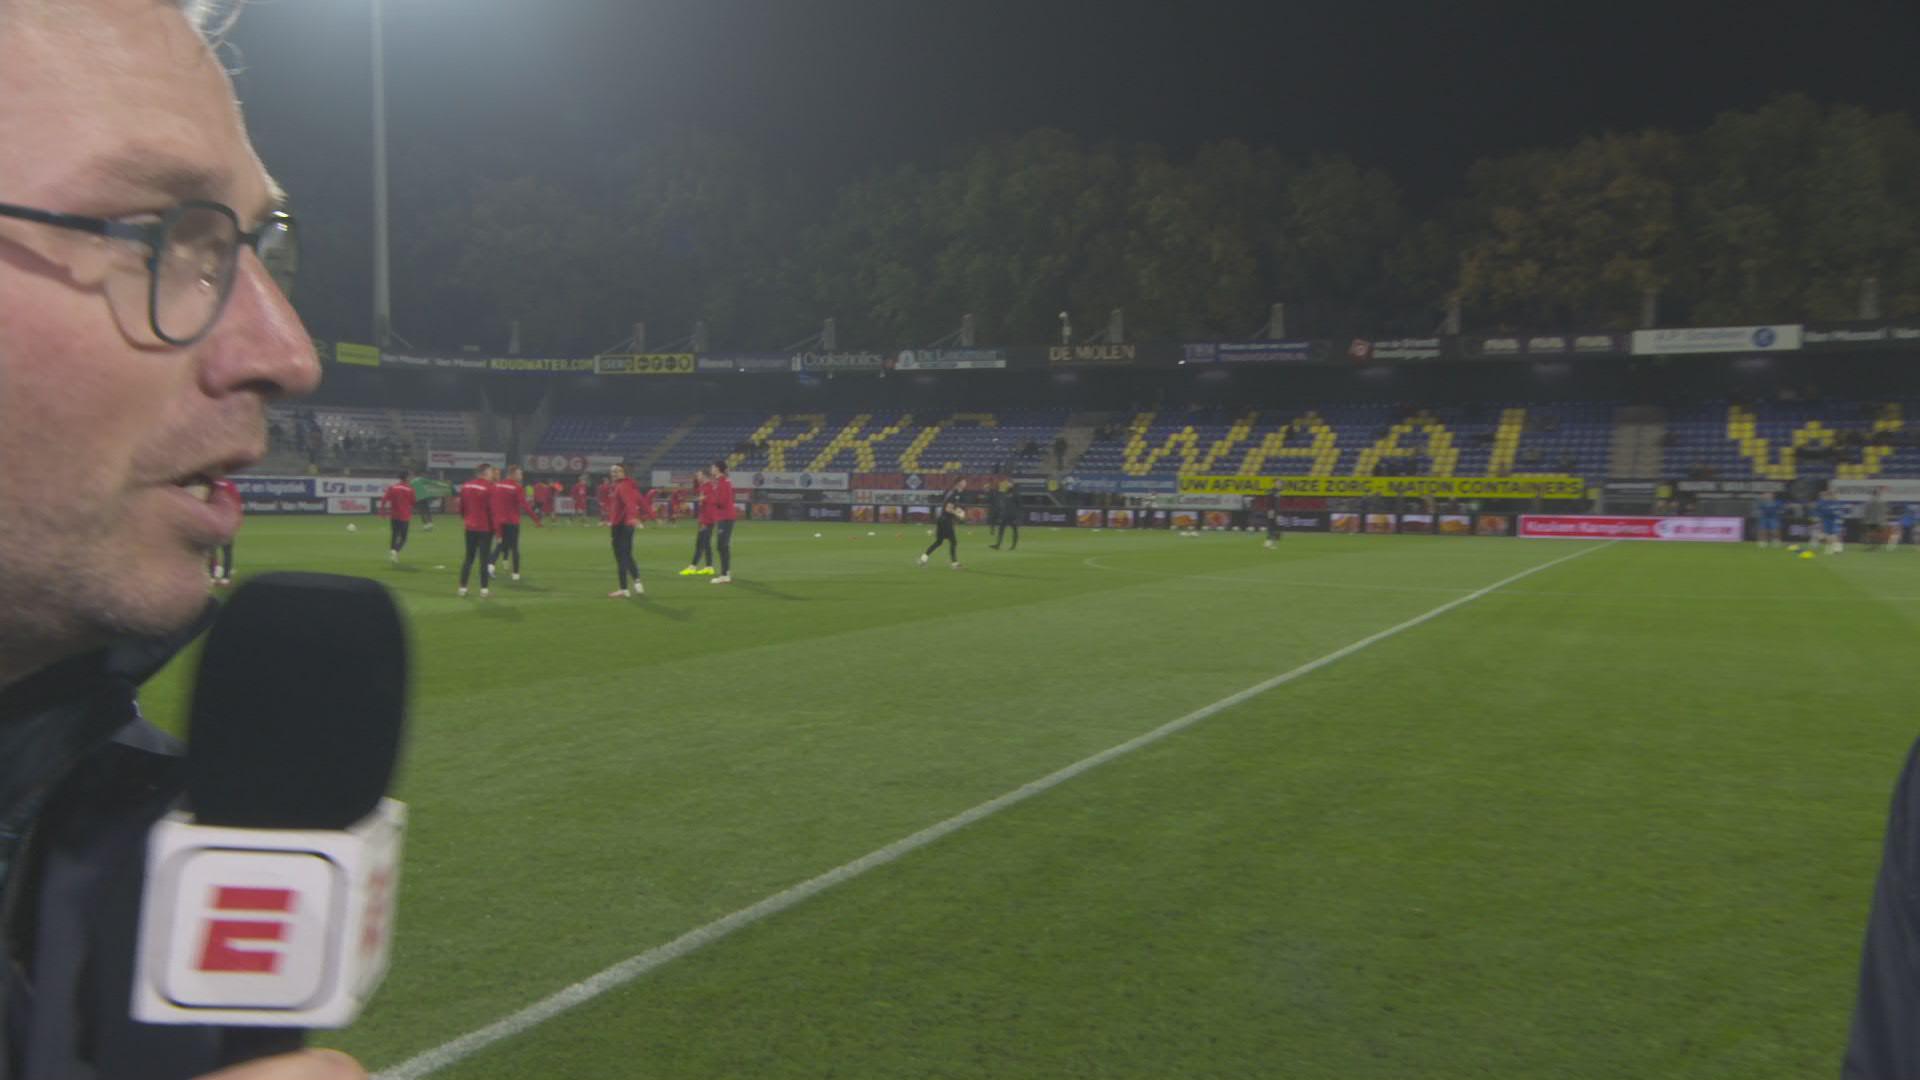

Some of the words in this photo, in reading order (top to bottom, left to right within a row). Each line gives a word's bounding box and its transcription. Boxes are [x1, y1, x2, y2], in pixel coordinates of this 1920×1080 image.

[1049, 346, 1073, 361] DE
[1076, 344, 1136, 360] MOLEN
[1181, 479, 1206, 491] UW
[1325, 480, 1372, 493] ZORG
